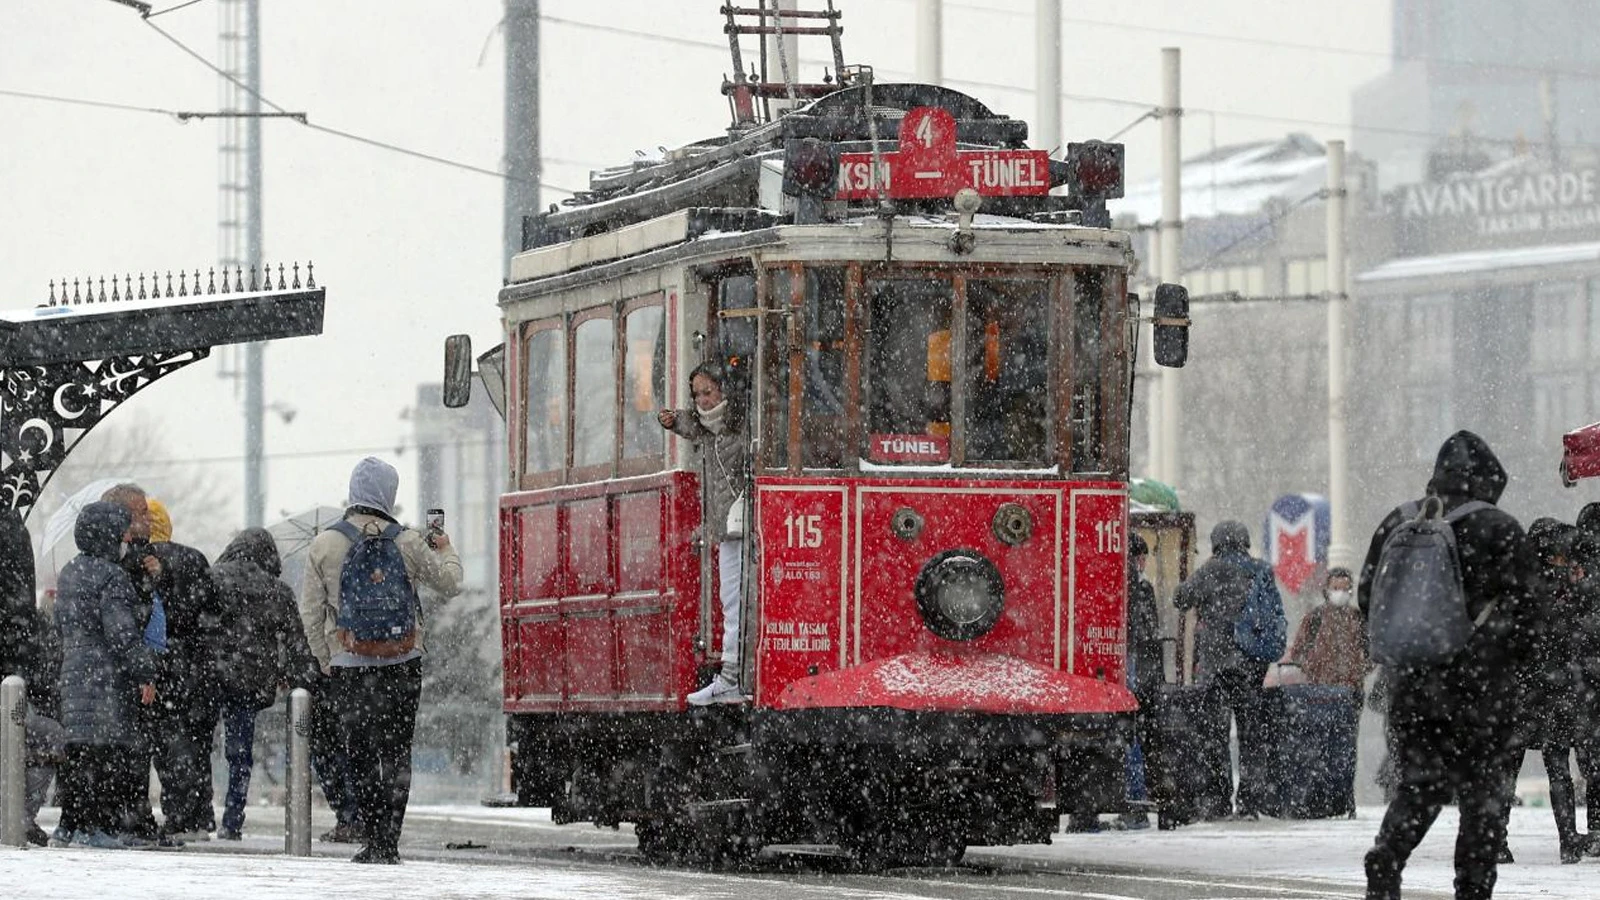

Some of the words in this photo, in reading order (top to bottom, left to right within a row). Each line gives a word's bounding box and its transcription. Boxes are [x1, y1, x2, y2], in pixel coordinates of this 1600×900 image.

[915, 114, 933, 149] 4
[969, 154, 1045, 188] TÜNEL
[1403, 169, 1596, 217] AVANTGARDE
[880, 438, 941, 455] TÜNEL
[784, 514, 823, 549] 115
[1095, 520, 1122, 553] 115
[798, 622, 828, 635] YASAK
